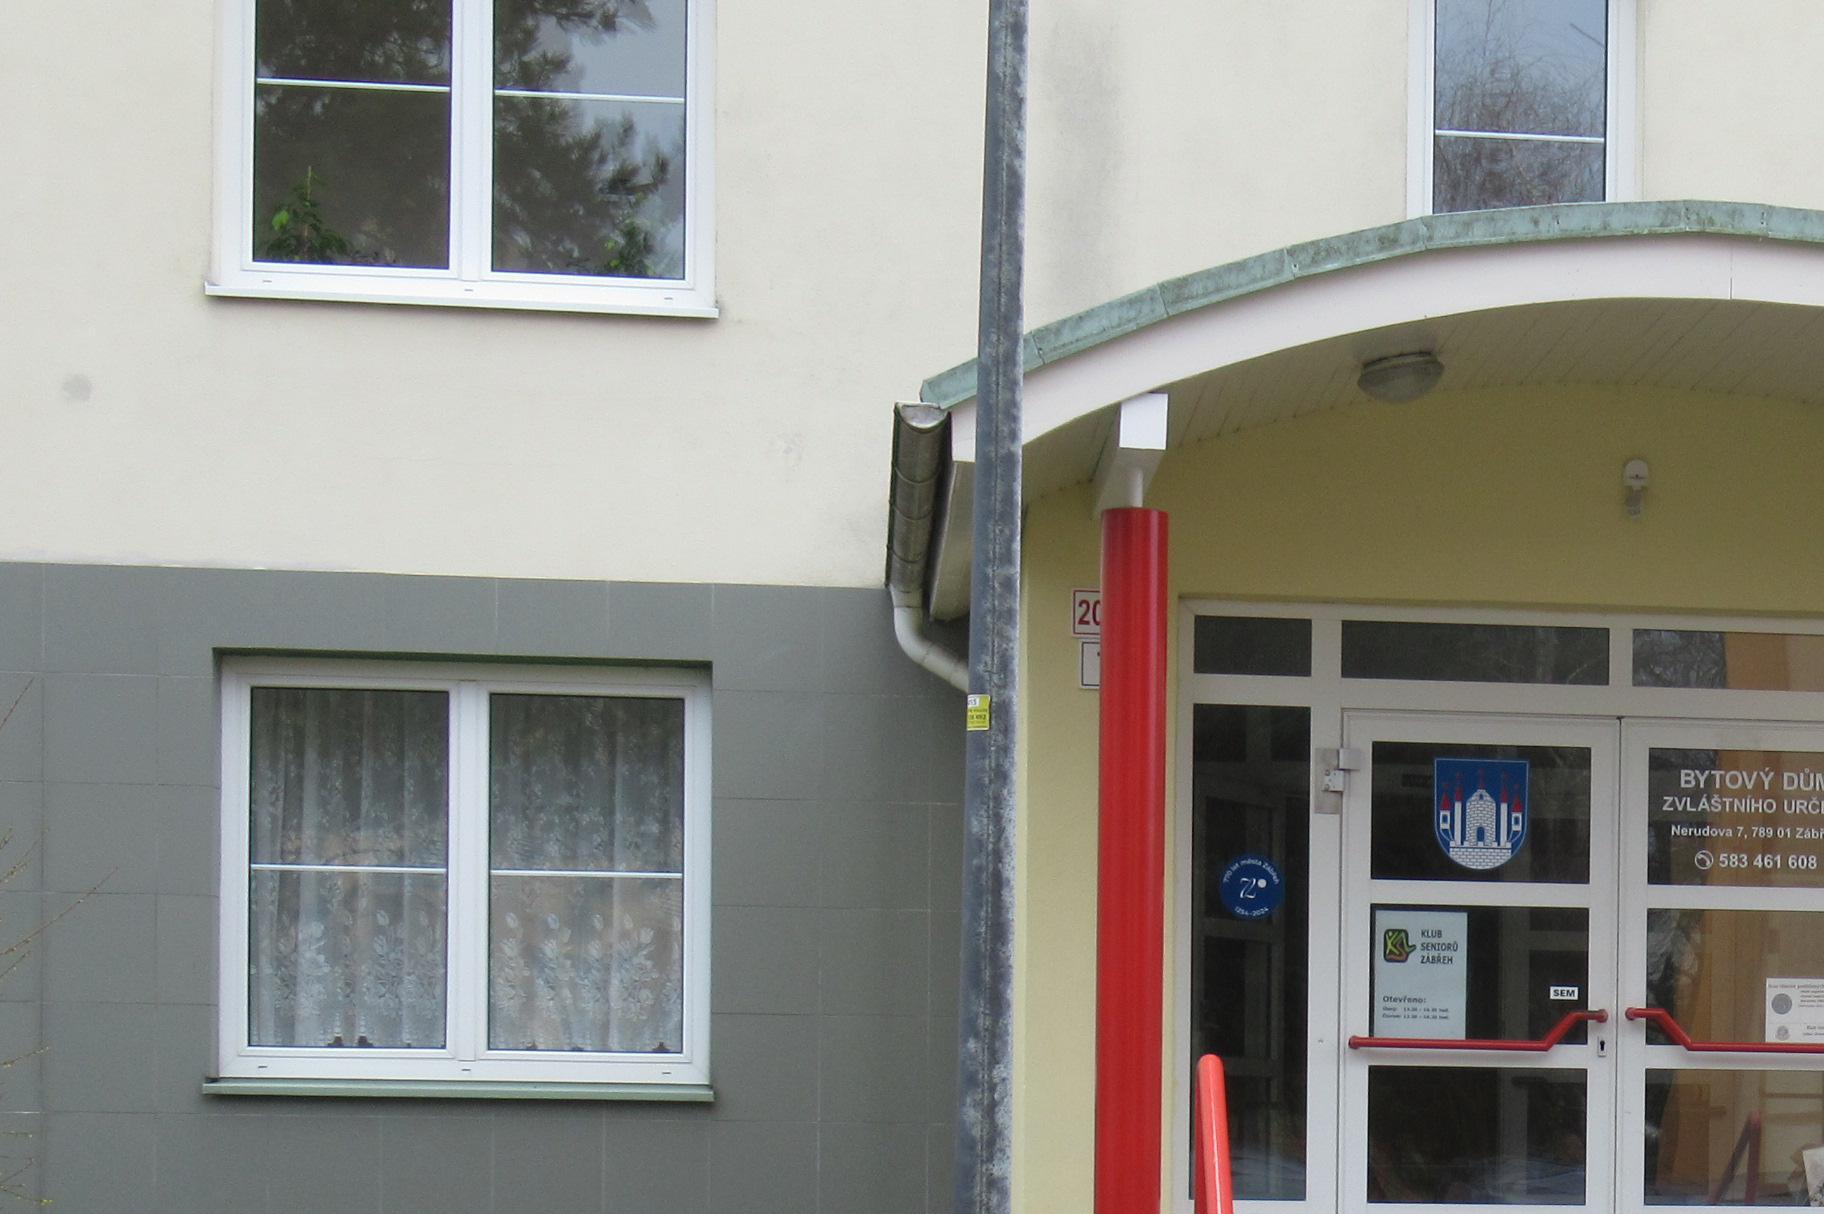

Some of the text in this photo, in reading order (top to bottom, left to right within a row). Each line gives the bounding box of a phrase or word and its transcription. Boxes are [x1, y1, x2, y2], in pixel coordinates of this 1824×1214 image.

[1680, 768, 1774, 790] BYTOVÝ
[1662, 794, 1777, 814] ZVLÁŠTNÍHO
[1671, 824, 1733, 838] Nerudova
[1737, 826, 1748, 840] 7,
[1752, 826, 1773, 838] 789
[1777, 827, 1791, 839] 01
[1719, 853, 1818, 870] 583 461 608
[1421, 929, 1443, 939] KLUB
[1420, 941, 1459, 952] SENIORŮ
[1420, 953, 1454, 965] ZÁBŘEH
[1382, 995, 1427, 1004] Otevřeno:
[1553, 989, 1576, 998] SEM
